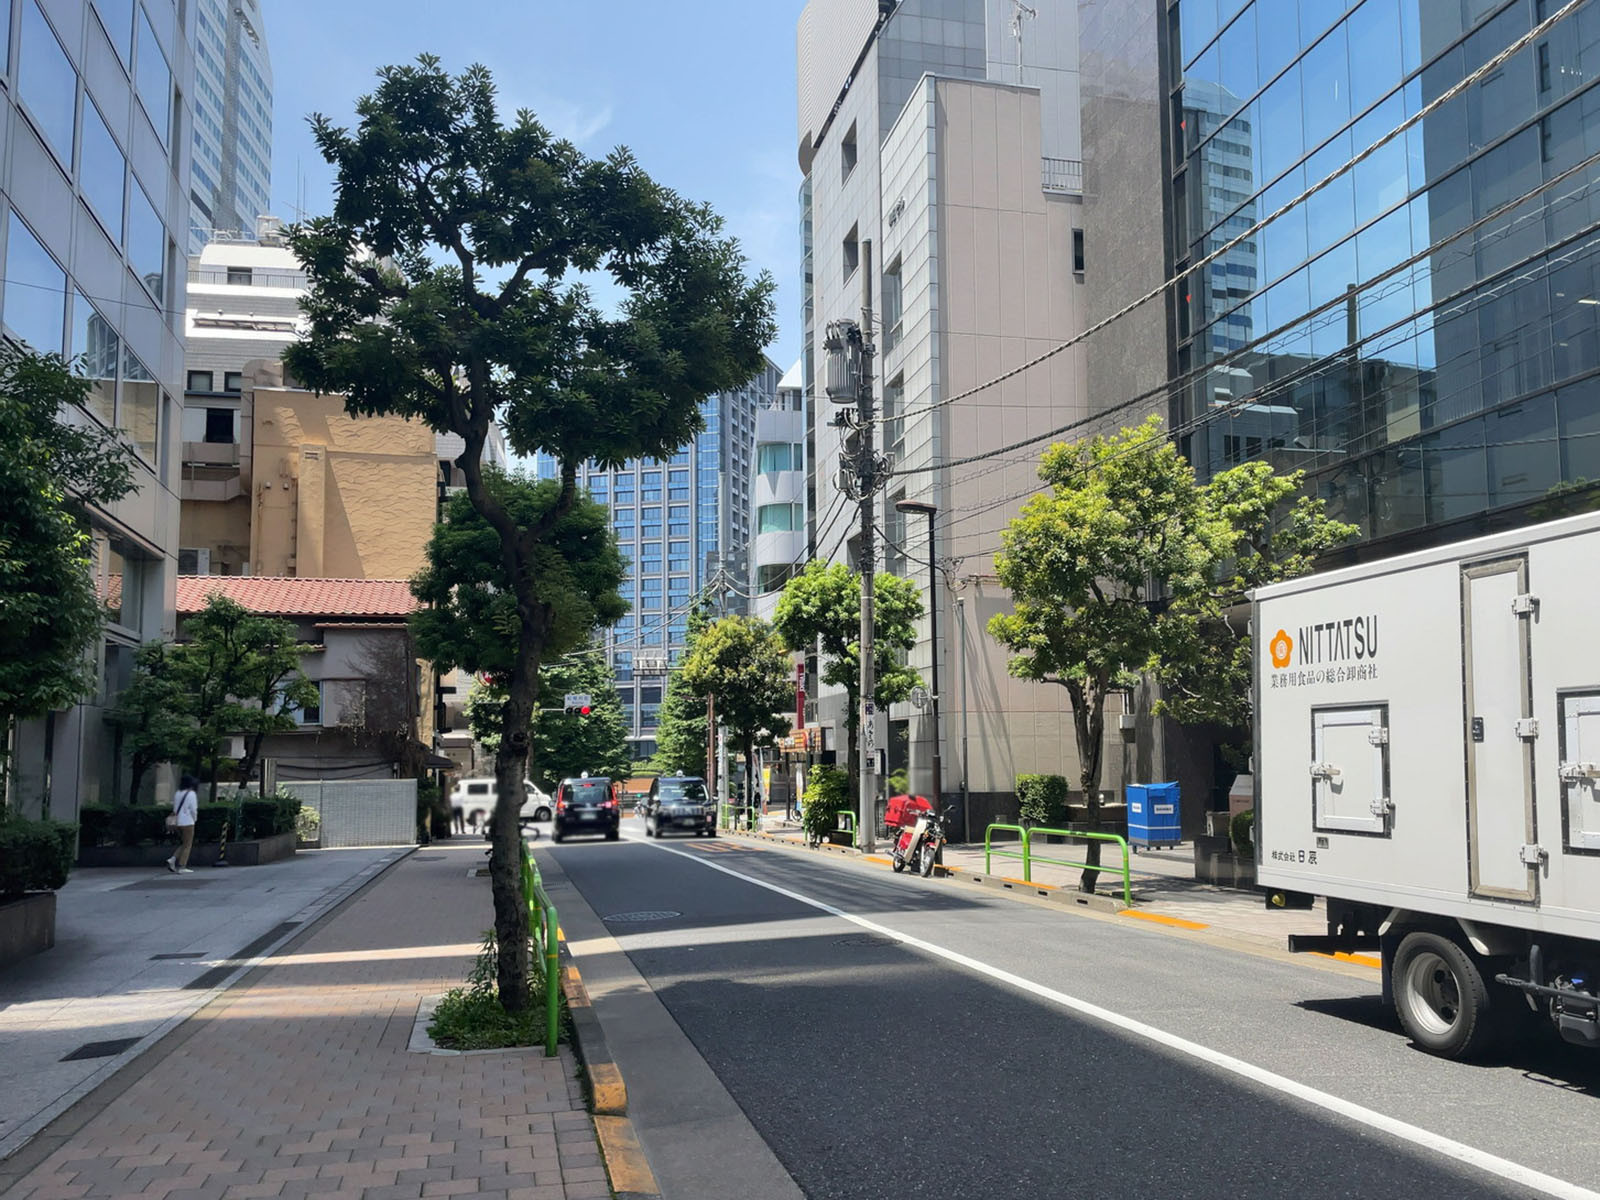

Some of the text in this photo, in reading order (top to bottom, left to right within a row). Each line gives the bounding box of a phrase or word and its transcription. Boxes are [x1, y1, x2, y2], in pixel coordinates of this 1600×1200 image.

[1299, 615, 1378, 665] NITTATSU
[1271, 664, 1378, 688] 業務用食品の総合卸商社
